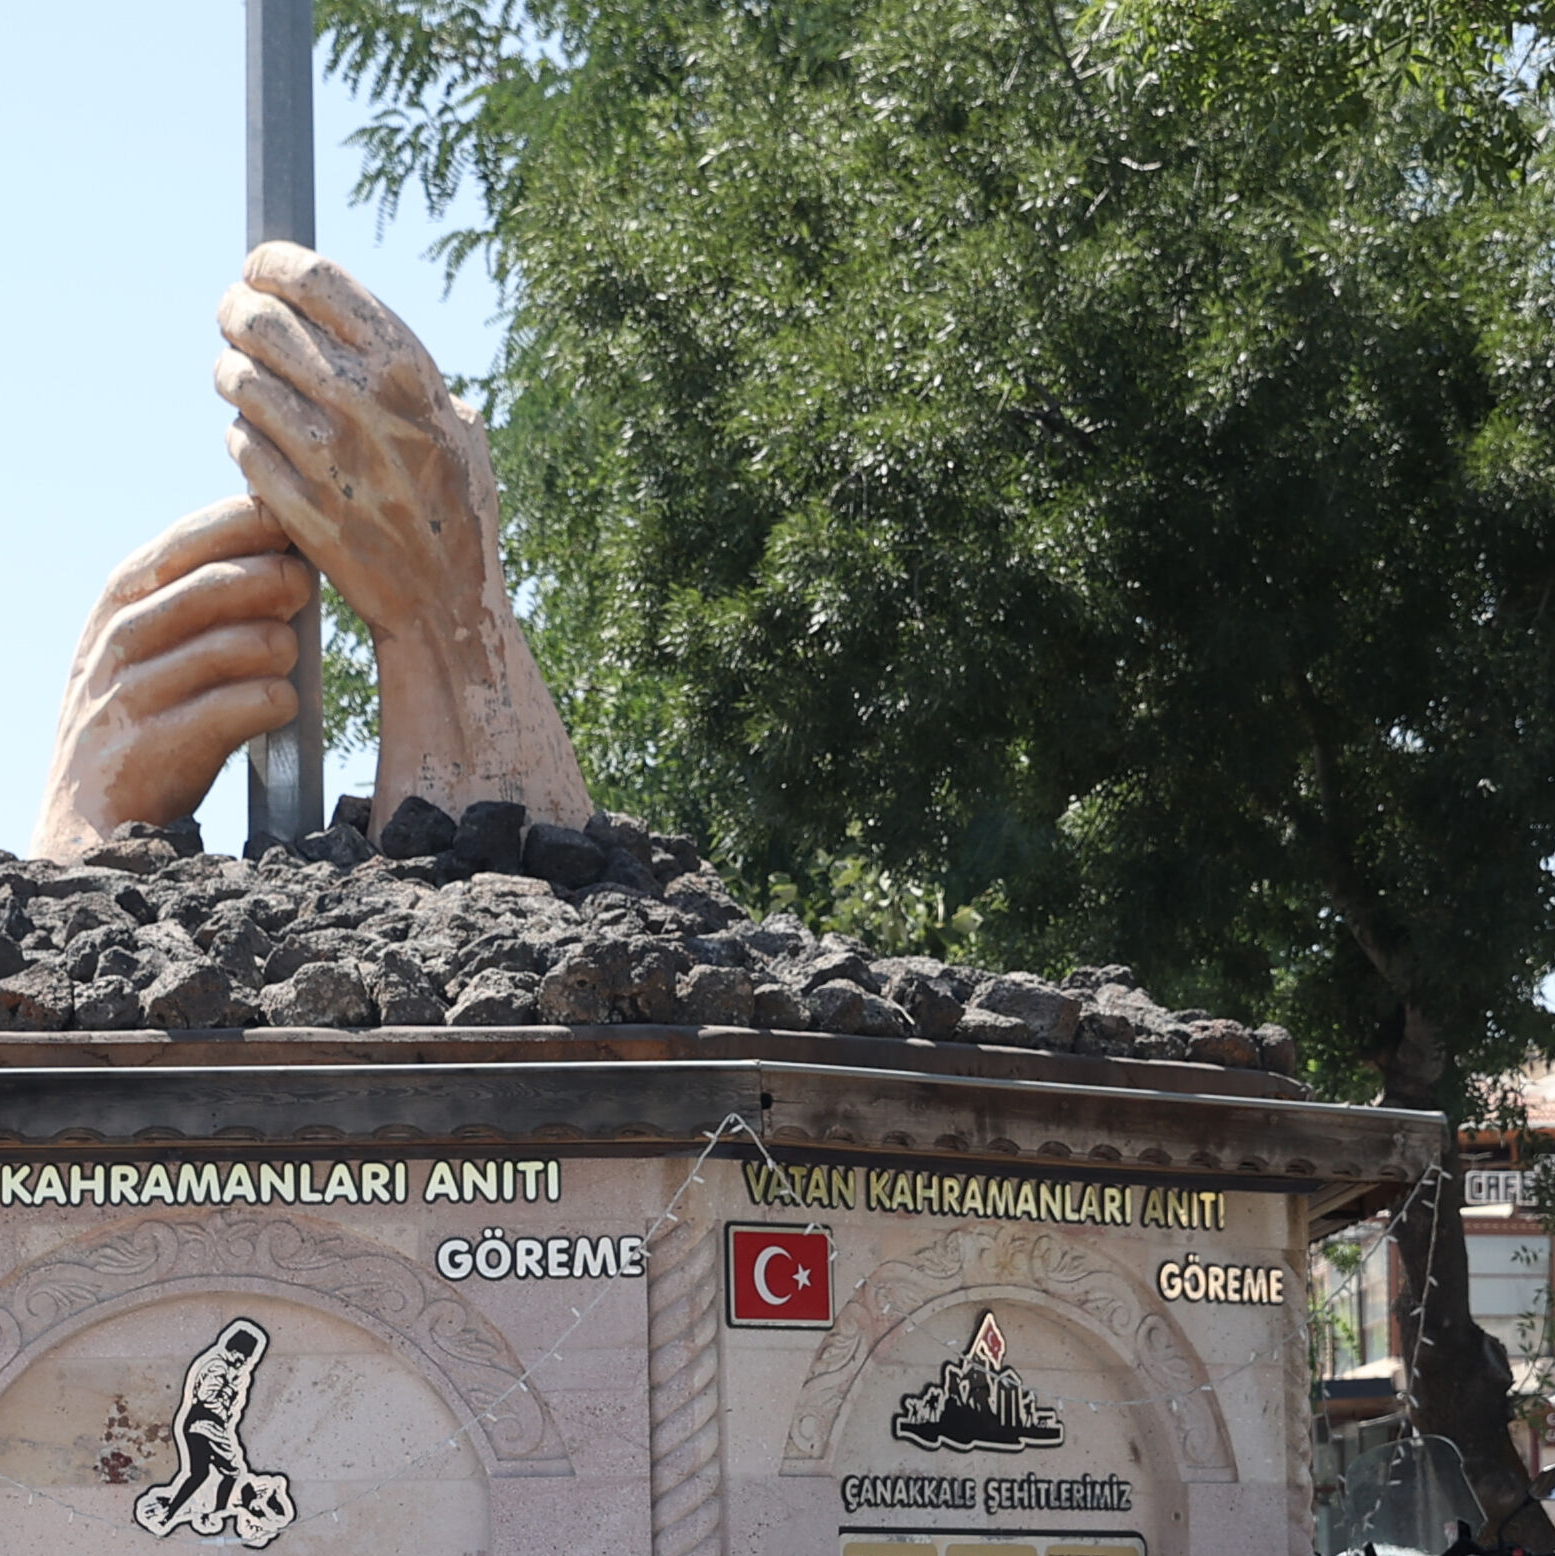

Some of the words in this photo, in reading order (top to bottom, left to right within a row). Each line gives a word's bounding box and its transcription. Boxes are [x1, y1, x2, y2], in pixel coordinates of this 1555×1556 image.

[0, 1160, 409, 1209] KAHRAMANLARI
[421, 1158, 561, 1205] ANITI
[744, 1160, 856, 1211] VATAN
[867, 1168, 1132, 1226] KAHRAMANLARI
[1142, 1190, 1226, 1231] ANITI
[436, 1228, 647, 1281] GÖREME
[1157, 1252, 1286, 1306] GÖREME
[841, 1475, 976, 1511] ÇANAKKALE
[984, 1473, 1132, 1515] ŞEHİTLERİMİZ
